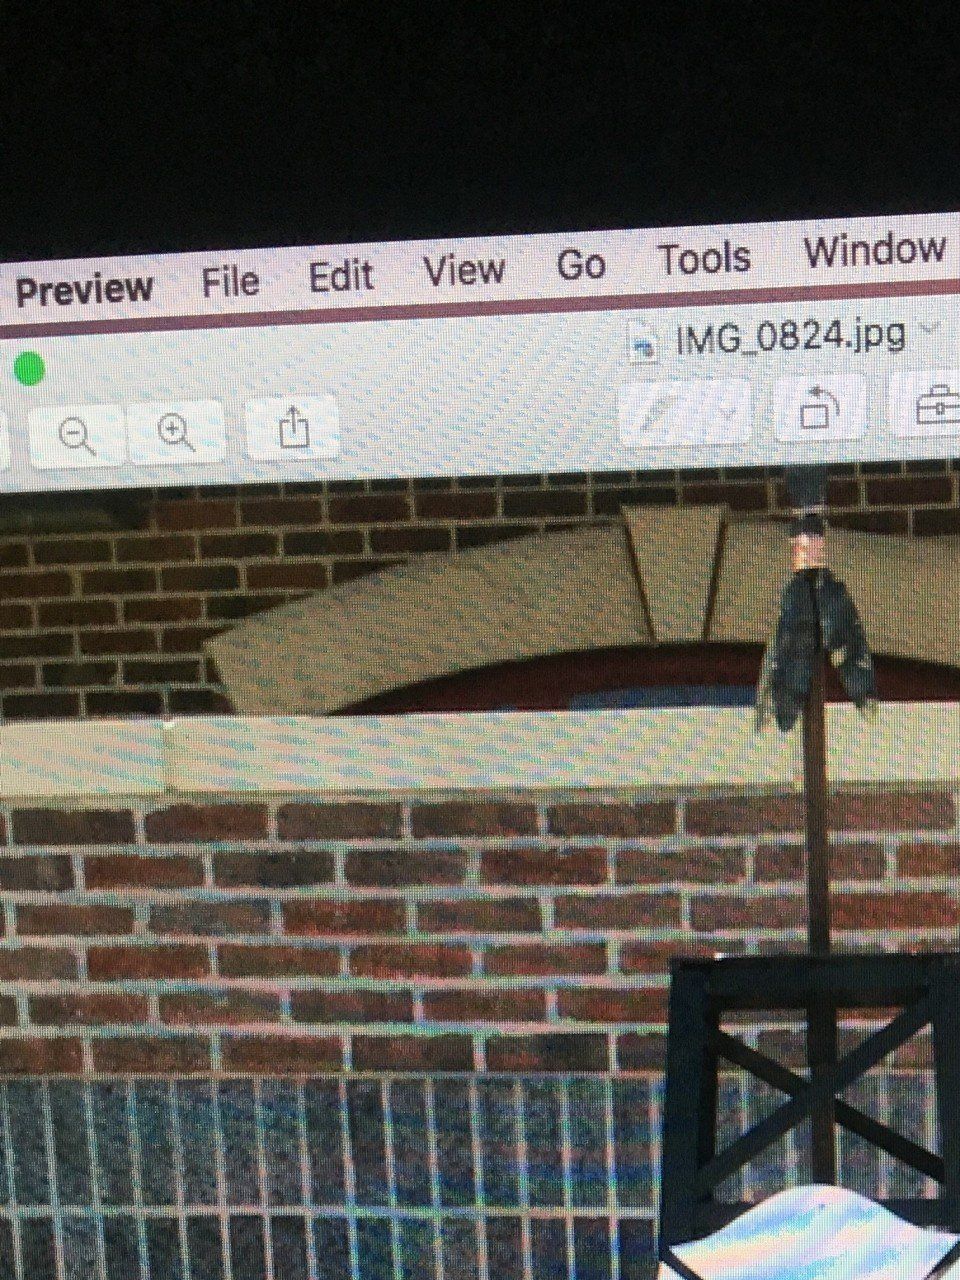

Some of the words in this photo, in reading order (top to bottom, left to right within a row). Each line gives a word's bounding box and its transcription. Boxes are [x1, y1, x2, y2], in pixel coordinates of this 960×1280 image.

[15, 271, 154, 308] Preview
[203, 265, 260, 298] File
[309, 258, 375, 293] Edit
[423, 253, 506, 287] View
[557, 248, 606, 281] Go
[657, 240, 752, 276] Tools
[804, 230, 947, 268] Window
[676, 315, 906, 356] IMG_0824.jpg
